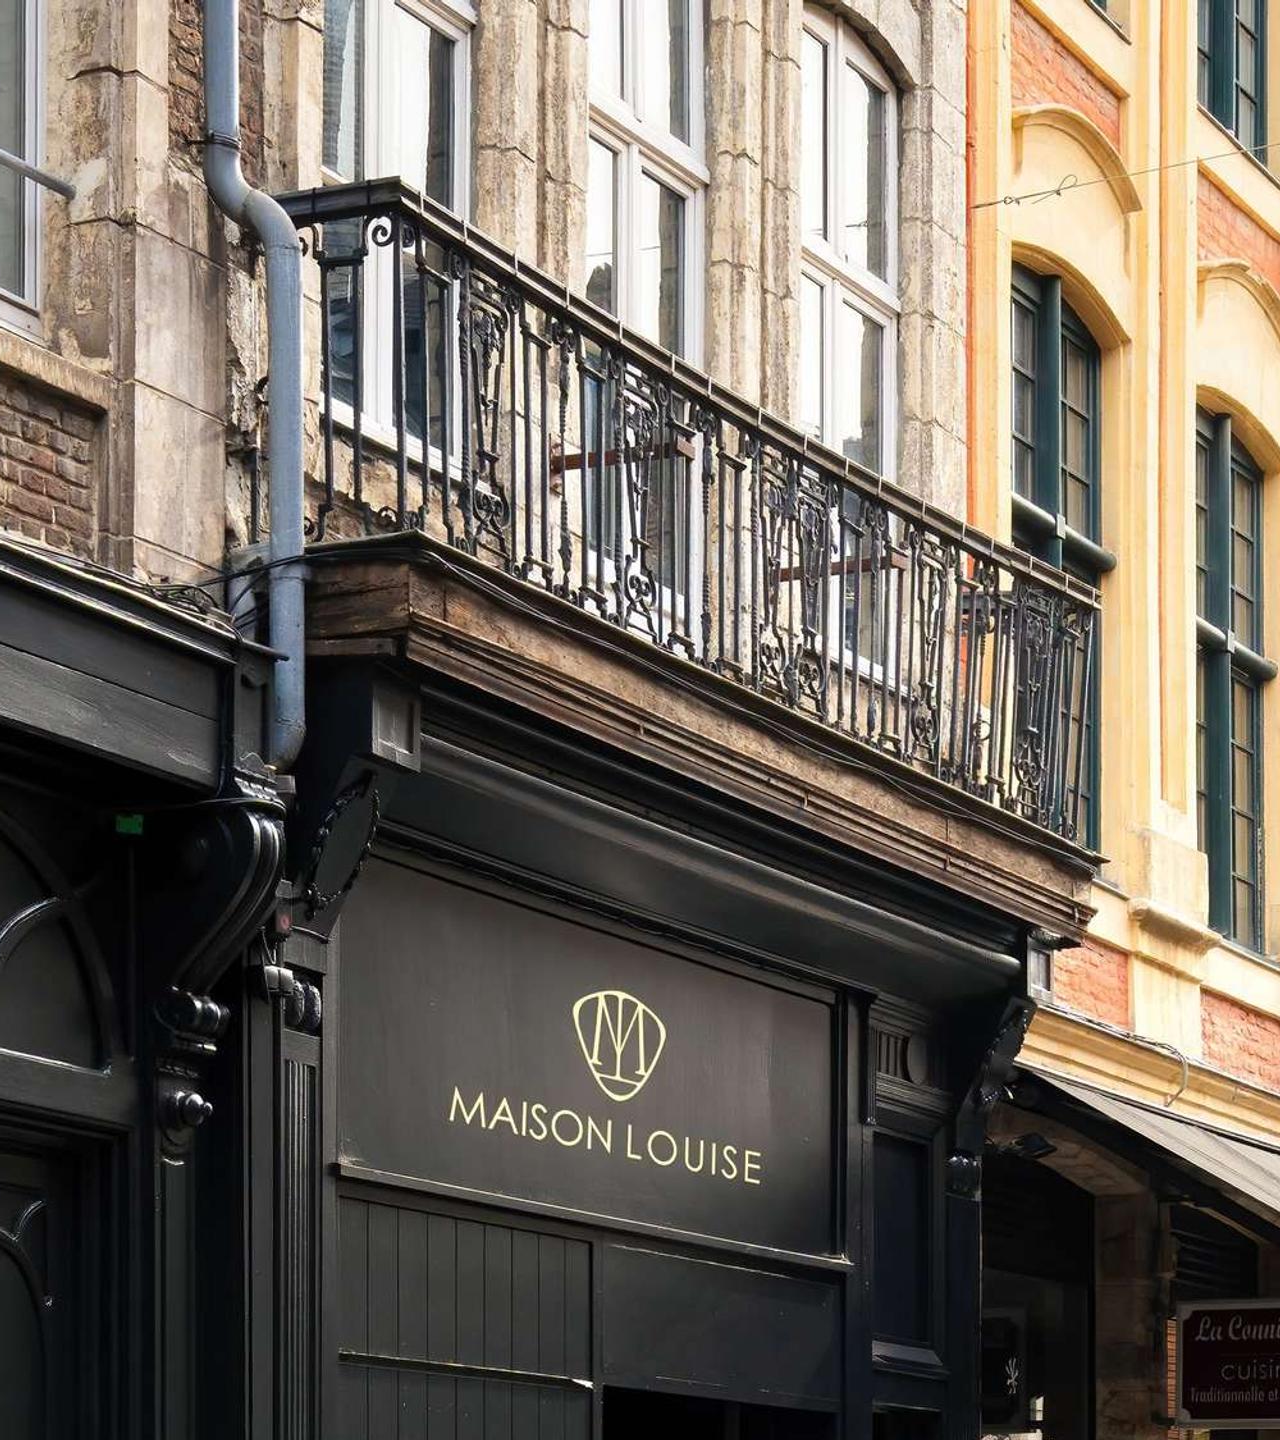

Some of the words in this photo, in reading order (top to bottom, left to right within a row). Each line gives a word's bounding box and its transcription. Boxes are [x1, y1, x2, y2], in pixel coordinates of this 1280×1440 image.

[449, 1086, 612, 1156] MAISON
[627, 1124, 762, 1186] LOUISE
[1195, 1315, 1223, 1342] La
[1190, 1386, 1265, 1403] Traditionnelle
[1268, 1387, 1280, 1402] et
